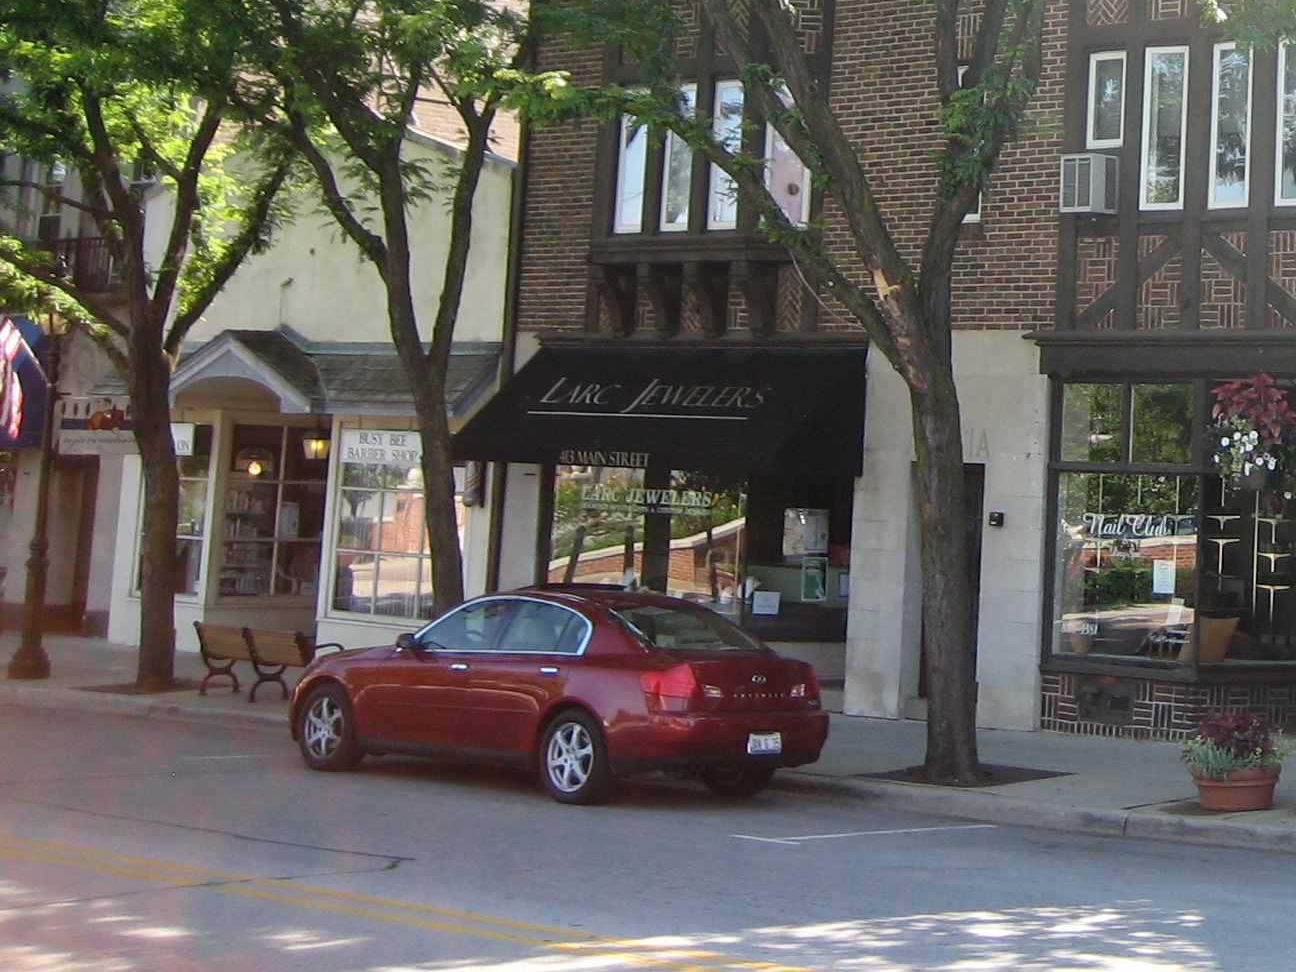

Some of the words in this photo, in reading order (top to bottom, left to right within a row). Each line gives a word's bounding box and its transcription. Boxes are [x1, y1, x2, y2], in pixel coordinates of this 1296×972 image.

[540, 377, 622, 405] LARC
[619, 378, 772, 414] JEWELERS
[359, 432, 382, 446] BUSY
[389, 434, 407, 446] BEE
[347, 447, 386, 461] BARBER
[391, 449, 418, 462] SHOP
[559, 450, 574, 465] 413
[577, 450, 607, 466] MAIN
[608, 451, 650, 468] STREET
[581, 484, 621, 502] LARC
[625, 488, 712, 508] JEWELERS
[1083, 513, 1127, 535] Nail
[1127, 514, 1173, 536] Club
